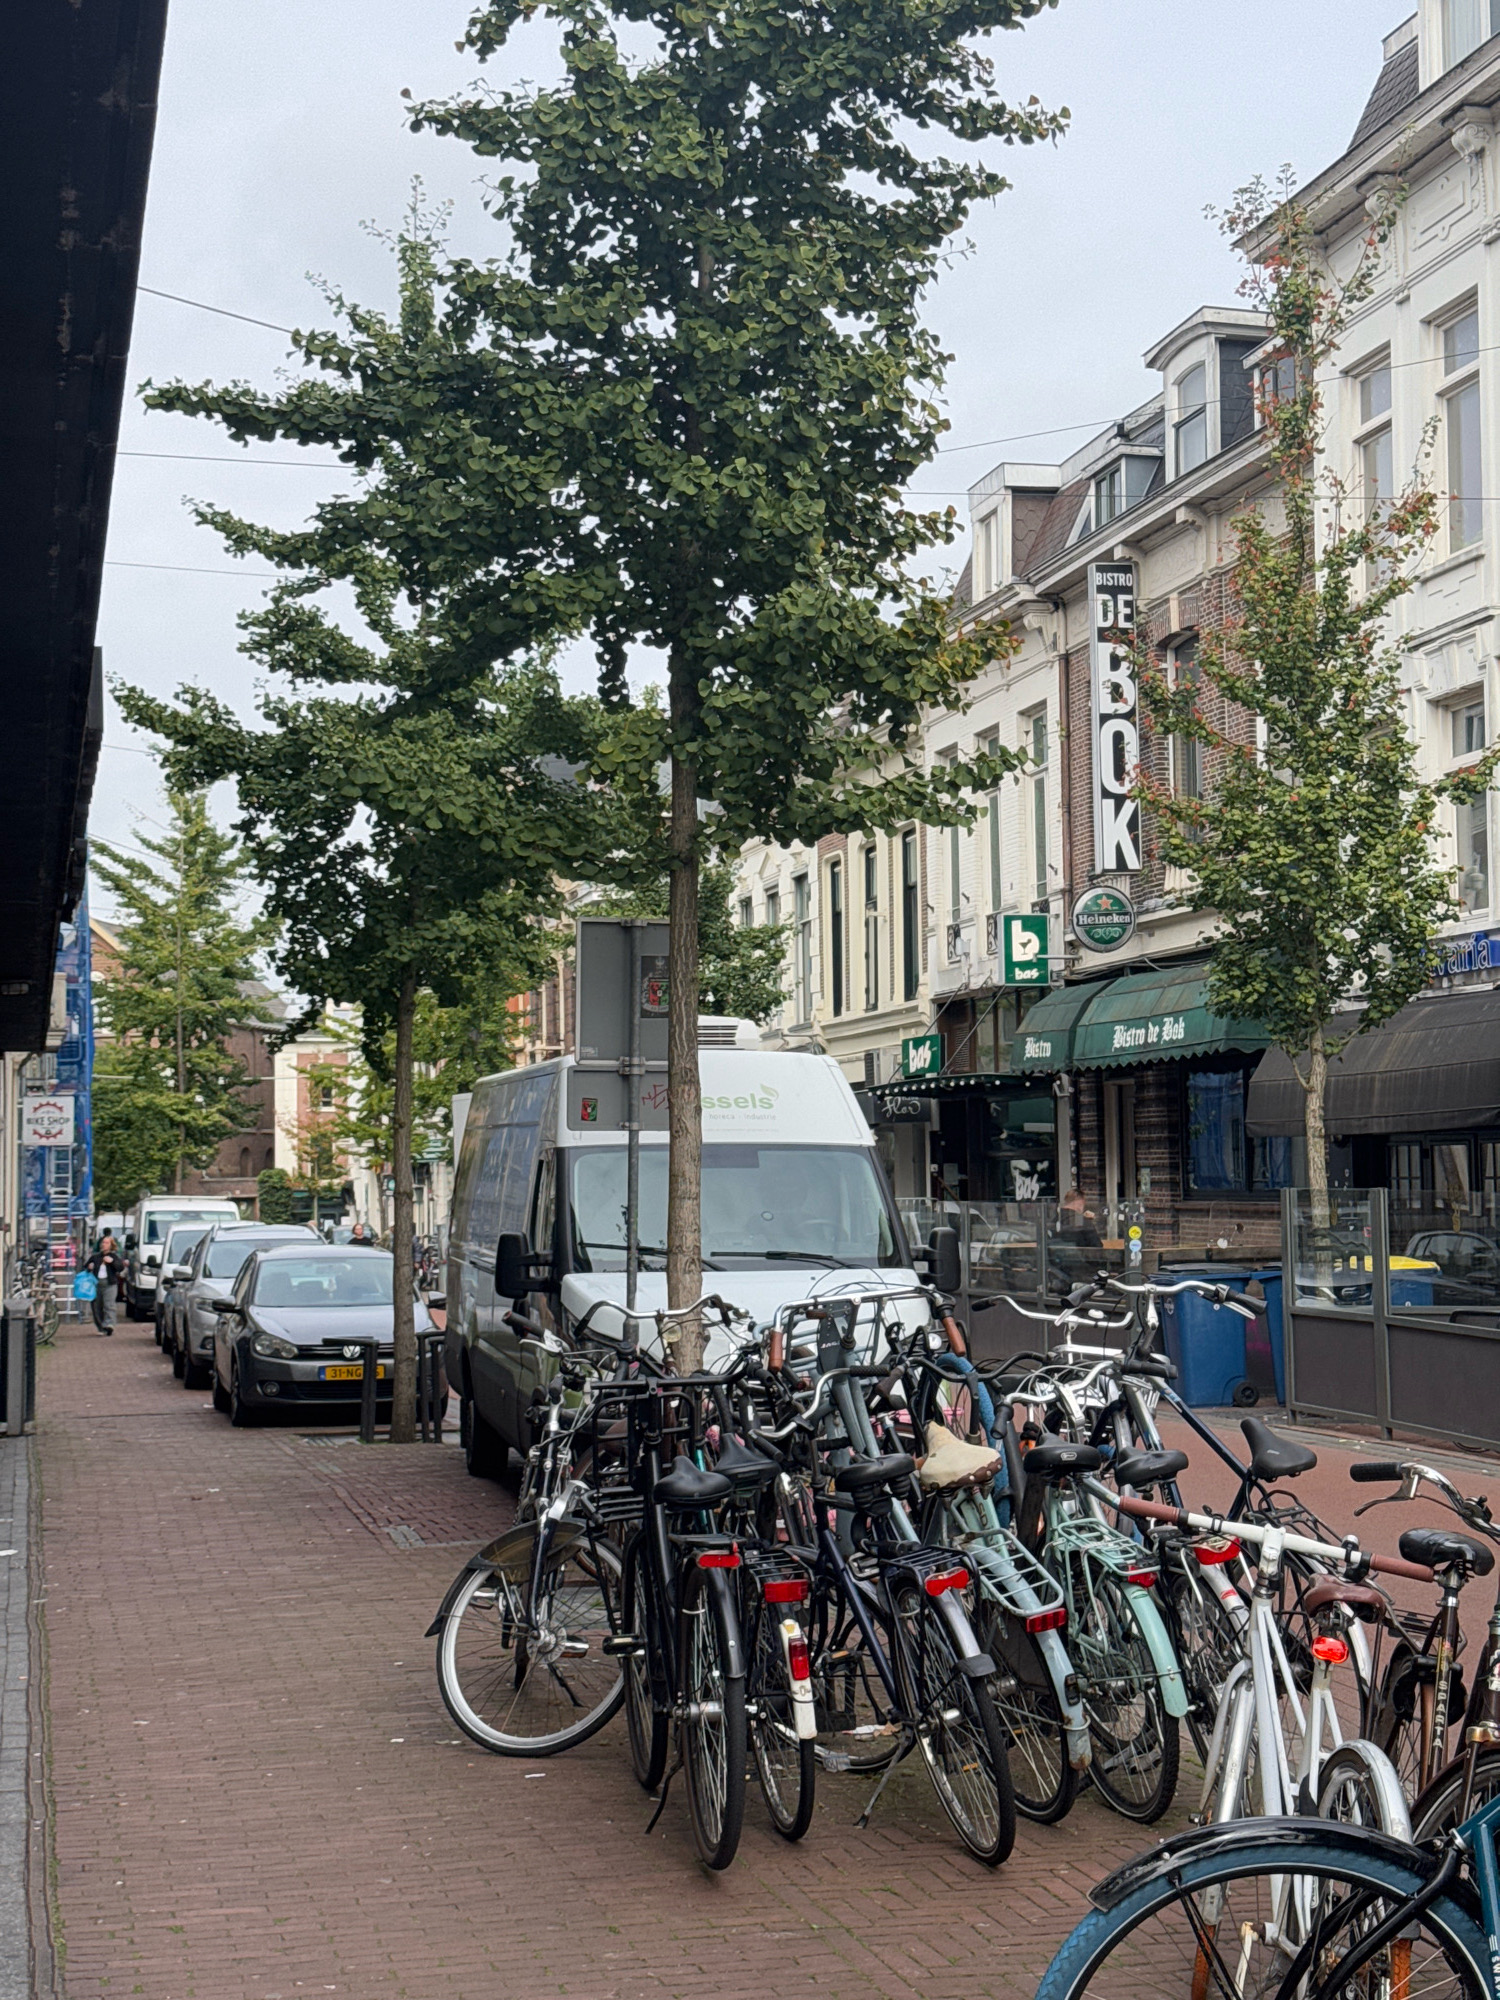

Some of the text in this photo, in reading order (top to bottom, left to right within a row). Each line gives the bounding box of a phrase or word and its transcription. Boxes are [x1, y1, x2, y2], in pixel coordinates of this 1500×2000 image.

[1096, 572, 1133, 586] BISTRO
[1097, 593, 1134, 628] DE
[1098, 642, 1140, 869] BOK
[1078, 914, 1130, 925] Heineken
[1014, 967, 1039, 980] bas
[1024, 1037, 1051, 1060] Bistro
[1112, 1025, 1145, 1052] Bistro
[1147, 1021, 1159, 1043] de
[908, 1040, 931, 1073] bas
[701, 1093, 774, 1109] ssels
[26, 1116, 70, 1125] BIKE SHOP
[1015, 1169, 1040, 1200] bas
[1432, 1680, 1448, 1748] SPARTA
